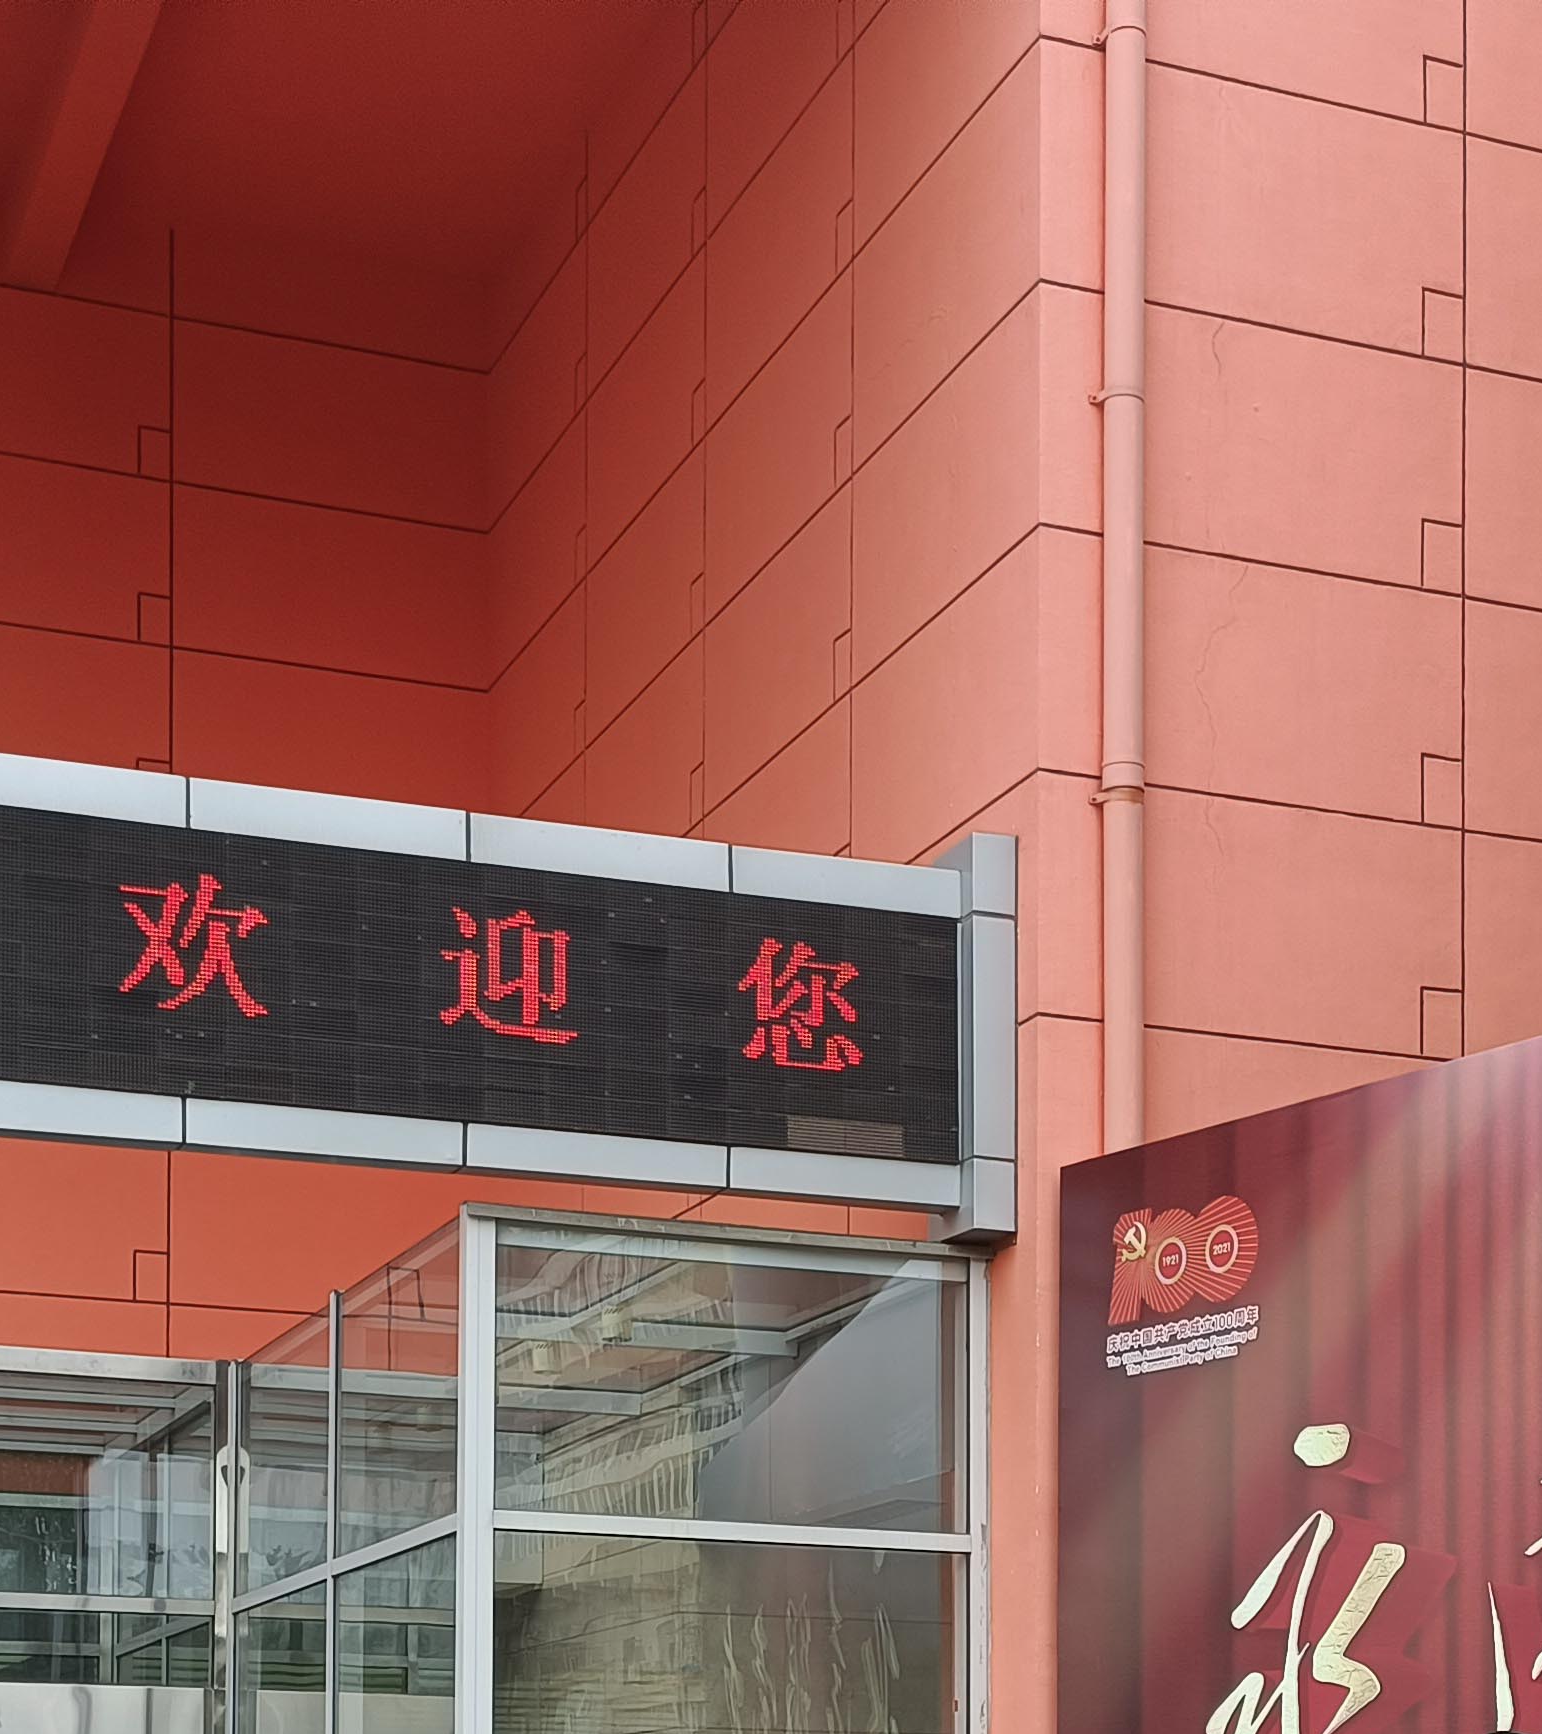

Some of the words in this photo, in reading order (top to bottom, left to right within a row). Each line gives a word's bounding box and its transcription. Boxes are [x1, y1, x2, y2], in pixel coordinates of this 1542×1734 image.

[1107, 1306, 1259, 1353] 庆祝中国共产党成立100周年
